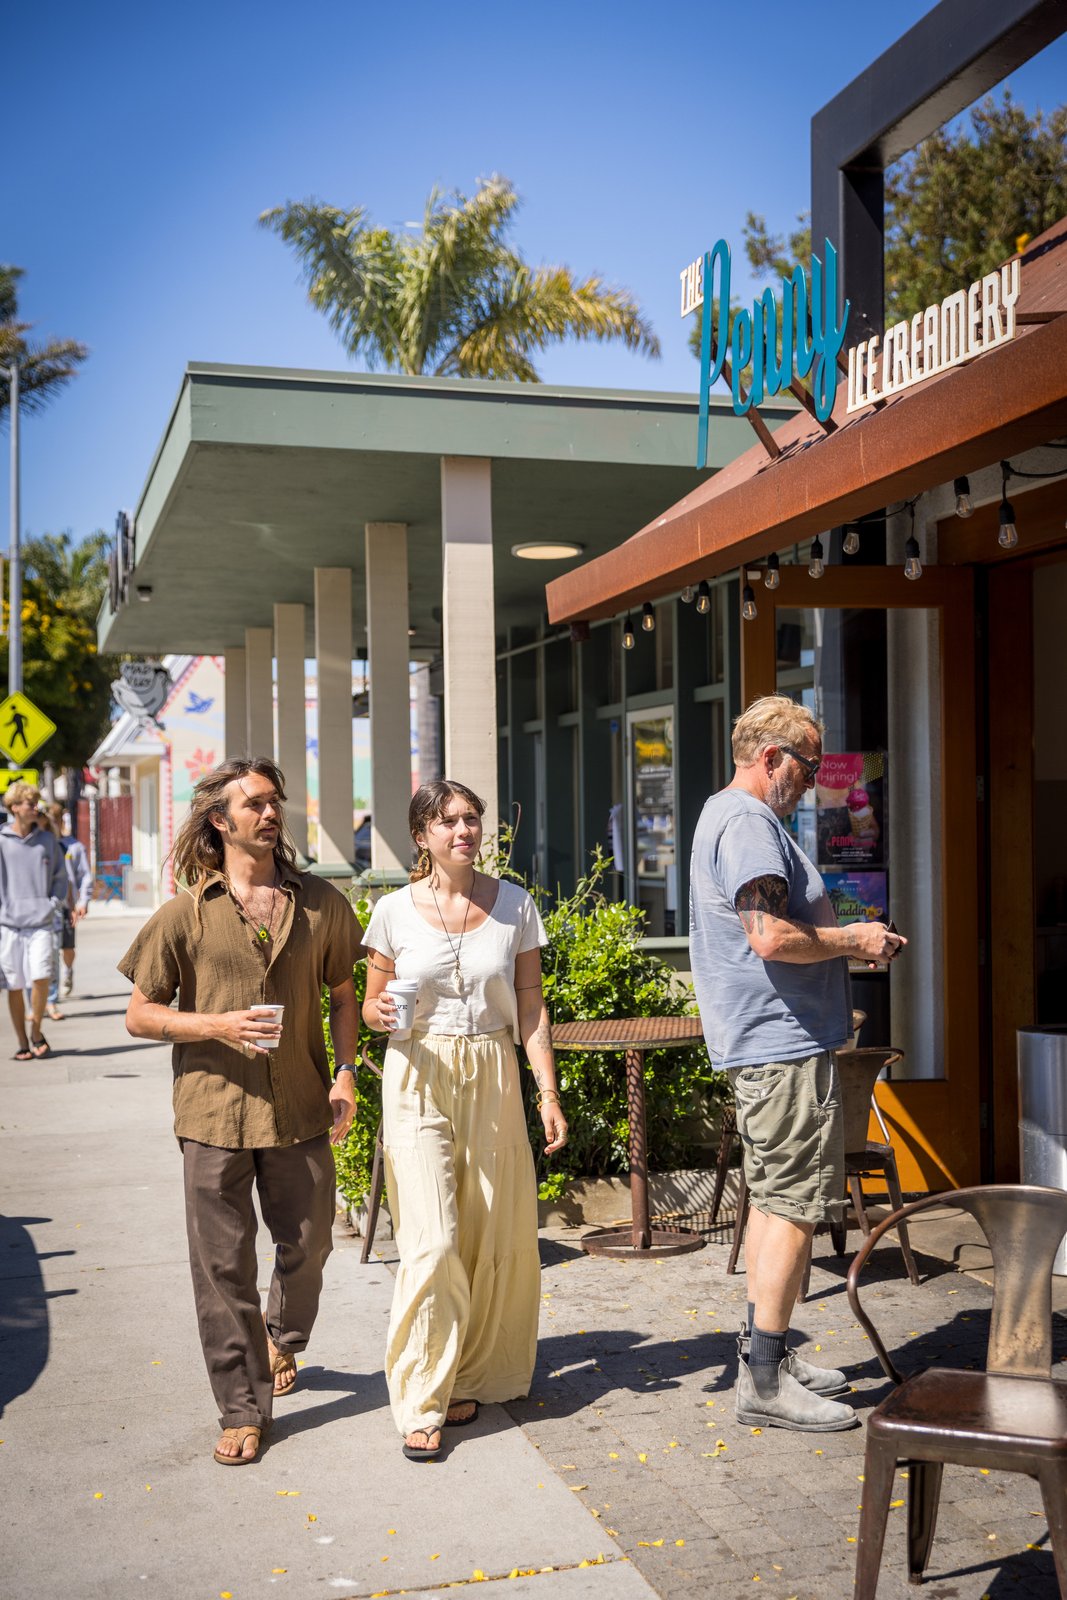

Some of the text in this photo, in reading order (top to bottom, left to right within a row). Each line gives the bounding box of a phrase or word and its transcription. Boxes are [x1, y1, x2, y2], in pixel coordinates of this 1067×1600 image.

[679, 256, 704, 318] THE
[696, 237, 850, 470] Penny
[846, 258, 1022, 414] ICE CREAMERY
[820, 761, 848, 770] Now
[820, 771, 858, 784] Hiring!
